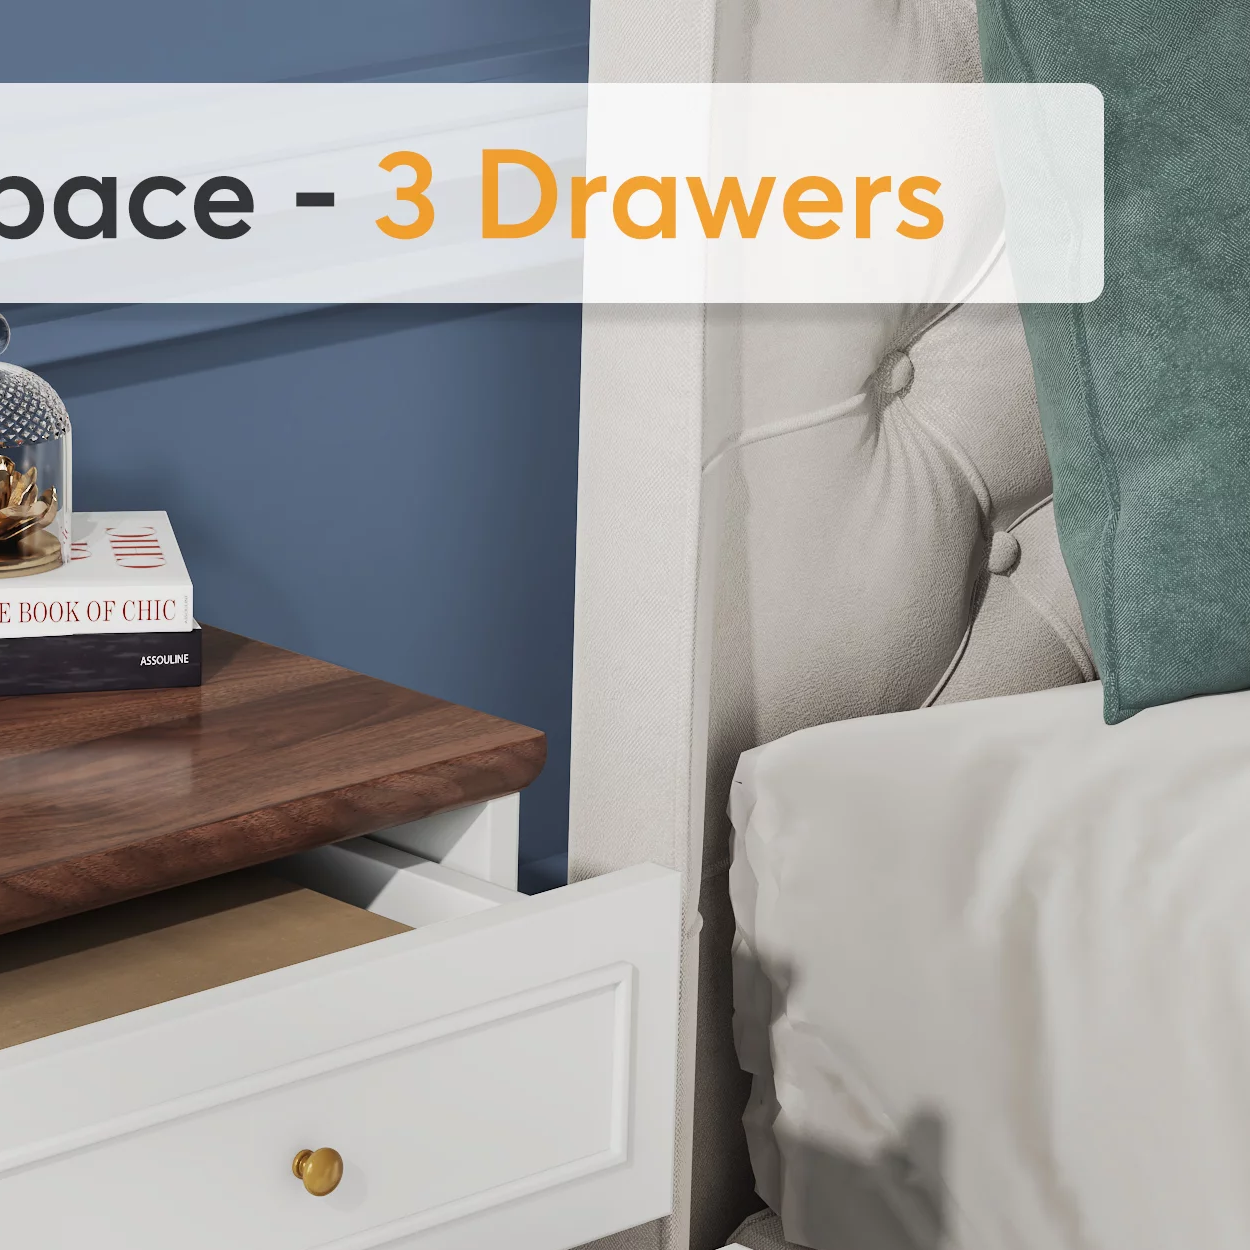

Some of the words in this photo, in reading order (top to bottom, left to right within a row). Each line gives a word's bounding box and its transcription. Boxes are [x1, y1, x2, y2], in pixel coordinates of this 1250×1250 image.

[18, 600, 81, 623] BOOK
[86, 599, 116, 622] OF
[121, 598, 178, 622] CHIC
[139, 653, 190, 667] ASSOULINE
